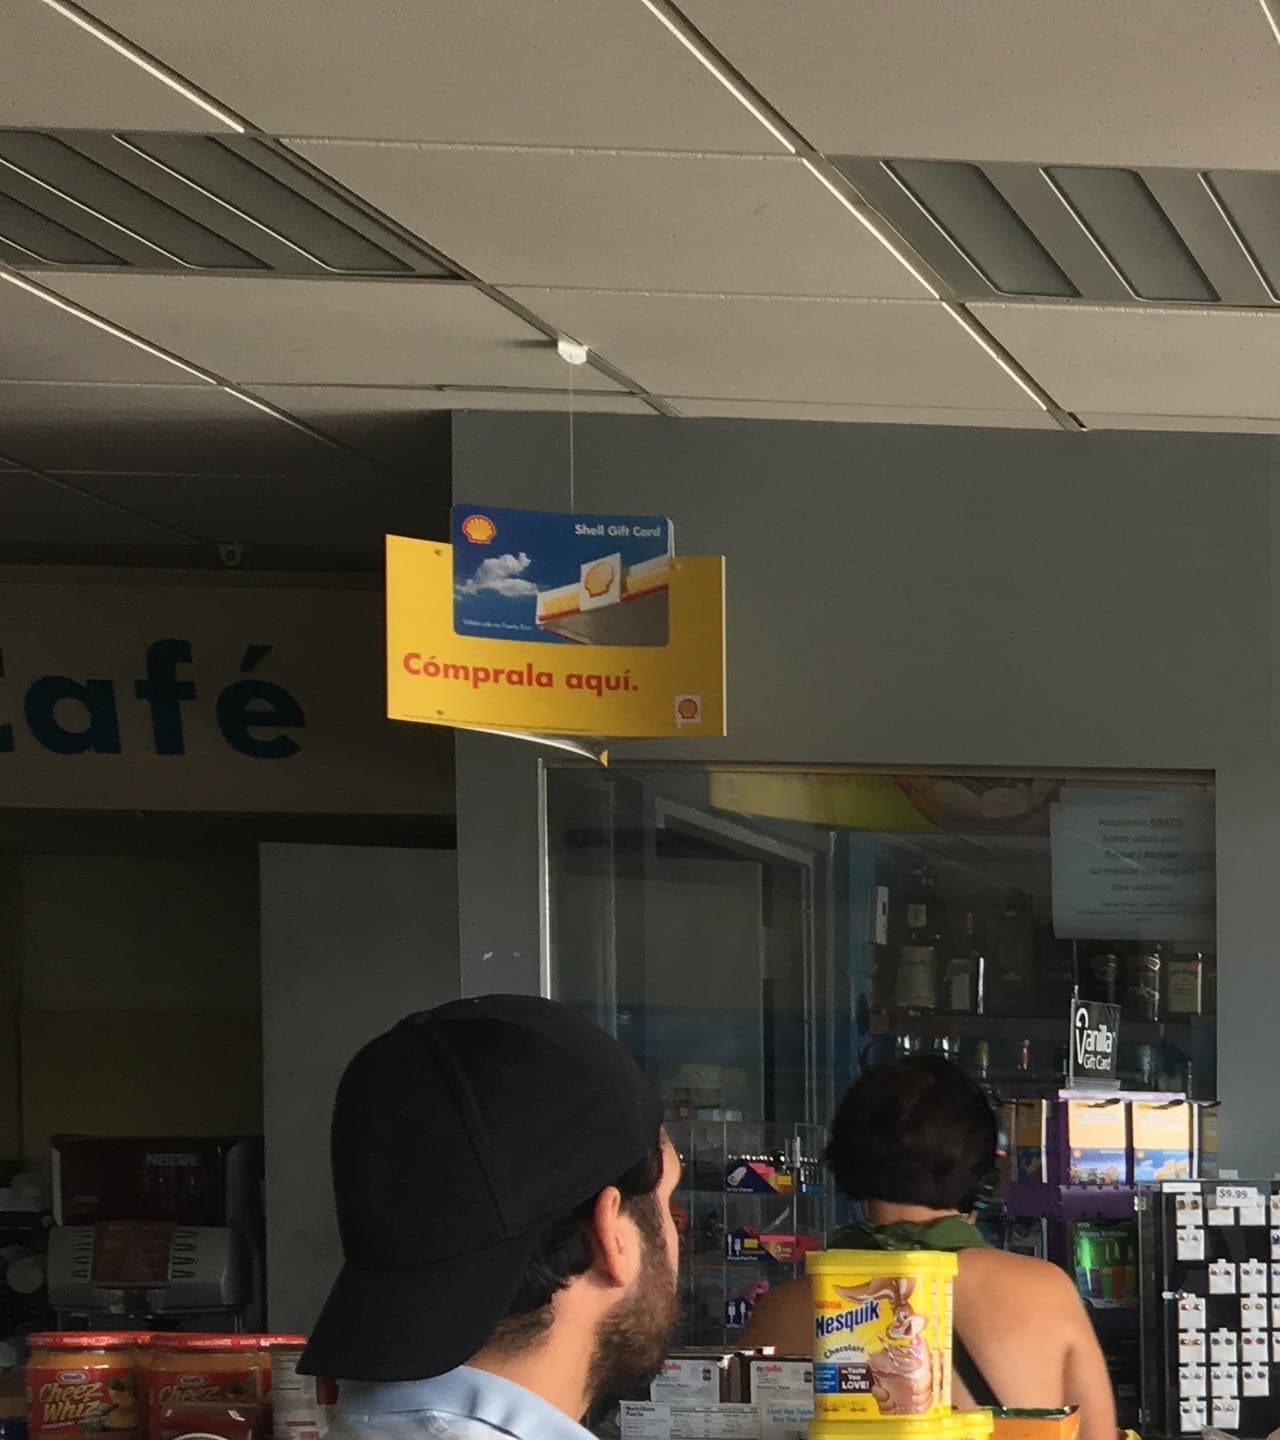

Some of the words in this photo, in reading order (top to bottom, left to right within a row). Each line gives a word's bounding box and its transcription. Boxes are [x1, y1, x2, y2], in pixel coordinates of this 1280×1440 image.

[574, 523, 605, 537] Shell
[607, 524, 630, 538] Gift
[632, 526, 661, 538] Card
[402, 652, 554, 689] Cómprala
[564, 668, 639, 697] aquí.
[0, 638, 306, 759] afé
[1083, 1055, 1096, 1070] Gift
[1096, 1055, 1112, 1070] Card
[1219, 1188, 1249, 1199] $9.99
[815, 1299, 881, 1338] Nesquik
[823, 1343, 866, 1360] Chocolate
[38, 1381, 104, 1401] Cheez
[158, 1383, 221, 1402] Cheez
[841, 1380, 870, 1390] LOVE!
[42, 1399, 102, 1422] Whiz
